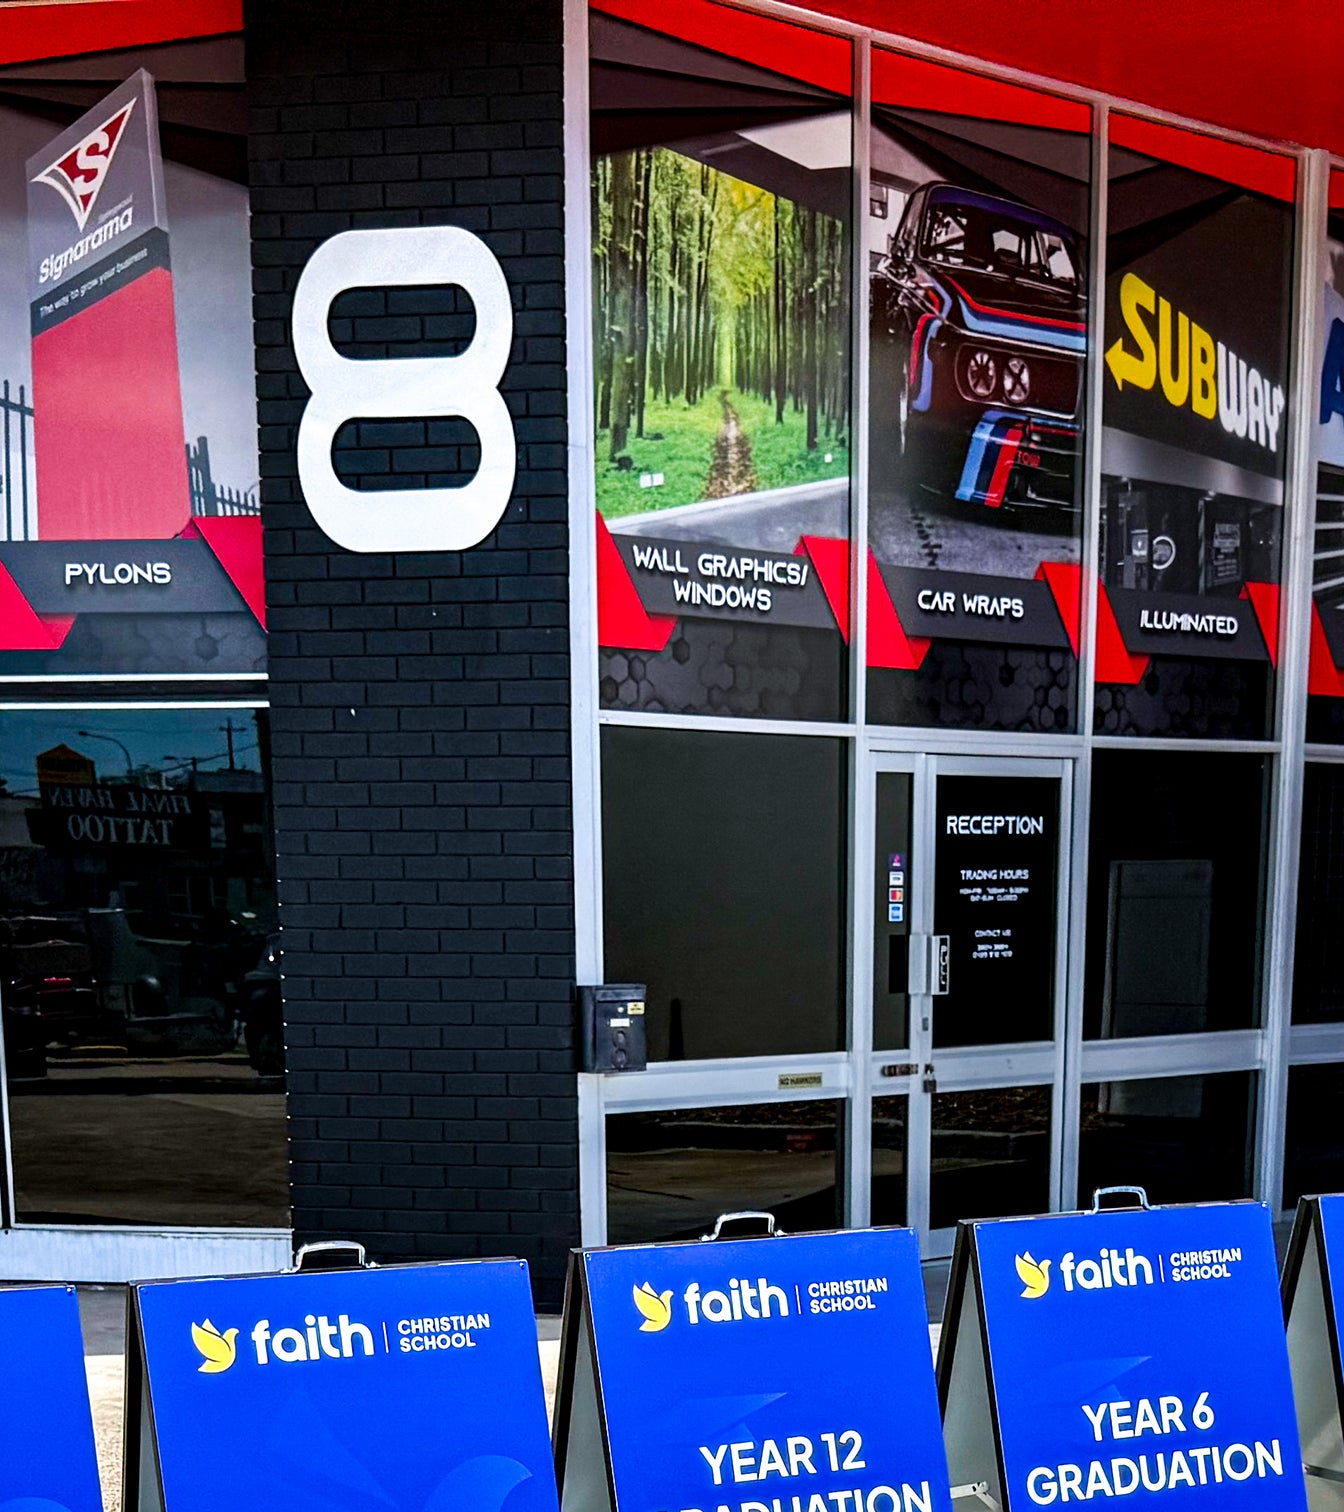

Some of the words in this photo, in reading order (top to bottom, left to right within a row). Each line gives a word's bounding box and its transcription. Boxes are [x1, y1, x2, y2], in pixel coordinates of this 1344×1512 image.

[38, 206, 133, 284] Signarama
[1105, 272, 1284, 452] SUBWAY
[291, 226, 516, 553] 8
[64, 562, 172, 585] PYLONS
[632, 544, 689, 575] WALL
[697, 552, 809, 586] GRAPHICS/
[673, 579, 773, 613] WINDOWS
[918, 590, 957, 613] CAR
[963, 594, 1025, 619] WRAPS
[1139, 610, 1239, 635] ILLUMINATED
[947, 815, 1044, 834] RECEPTION
[960, 869, 997, 880] TRADING
[999, 868, 1029, 880] HOURS
[1059, 1248, 1154, 1291] faith
[1170, 1248, 1242, 1266] CHRISTIAN
[1172, 1263, 1231, 1281] SCHOOL
[683, 1278, 789, 1324] faith
[808, 1277, 888, 1298] CHRISTIAN
[810, 1294, 876, 1314] SCHOOL
[251, 1314, 374, 1365] faith
[397, 1313, 491, 1335] CHRISTIAN
[400, 1331, 476, 1353] SCHOOL
[1082, 1395, 1187, 1441] YEAR
[1192, 1391, 1215, 1431] 6
[699, 1435, 817, 1486] YEAR
[820, 1430, 866, 1471] 12
[1027, 1439, 1284, 1506] GRADUATION
